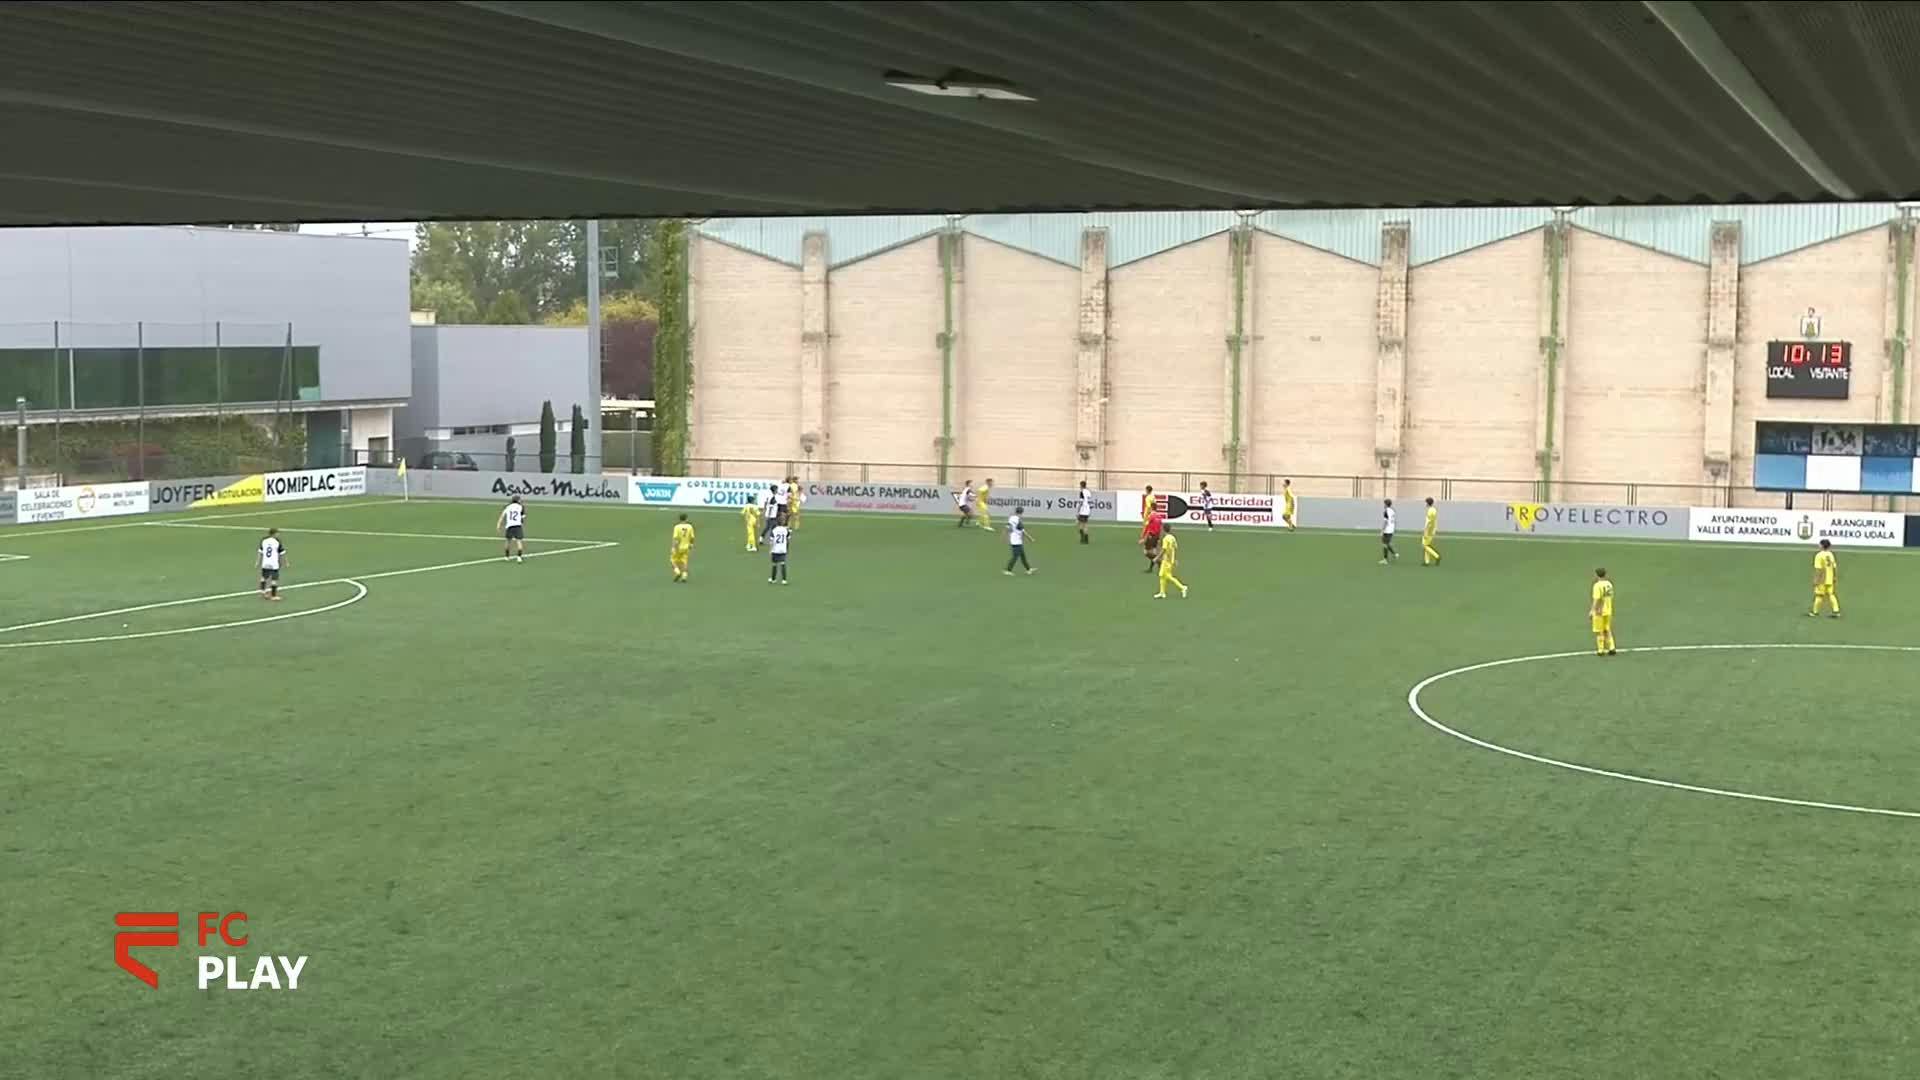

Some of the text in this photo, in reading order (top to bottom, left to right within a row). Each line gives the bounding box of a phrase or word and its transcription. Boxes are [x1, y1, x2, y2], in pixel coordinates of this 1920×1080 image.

[1768, 367, 1794, 378] LOCAL
[492, 478, 548, 496] Asador
[644, 487, 671, 498] JOKIN
[879, 484, 940, 499] PAMPLONA
[153, 484, 215, 504] JOYFER
[1046, 499, 1053, 510] y
[509, 510, 519, 521] 12
[1506, 506, 1668, 526] PROYELECTRO
[1711, 515, 1777, 525] AYUNTAMIENTO
[1831, 518, 1885, 528] ARANGUREN
[1697, 525, 1791, 536] VALLE DE ARANGUREN
[1864, 531, 1895, 539] UDALA
[776, 533, 785, 544] 21
[265, 546, 273, 558] 8
